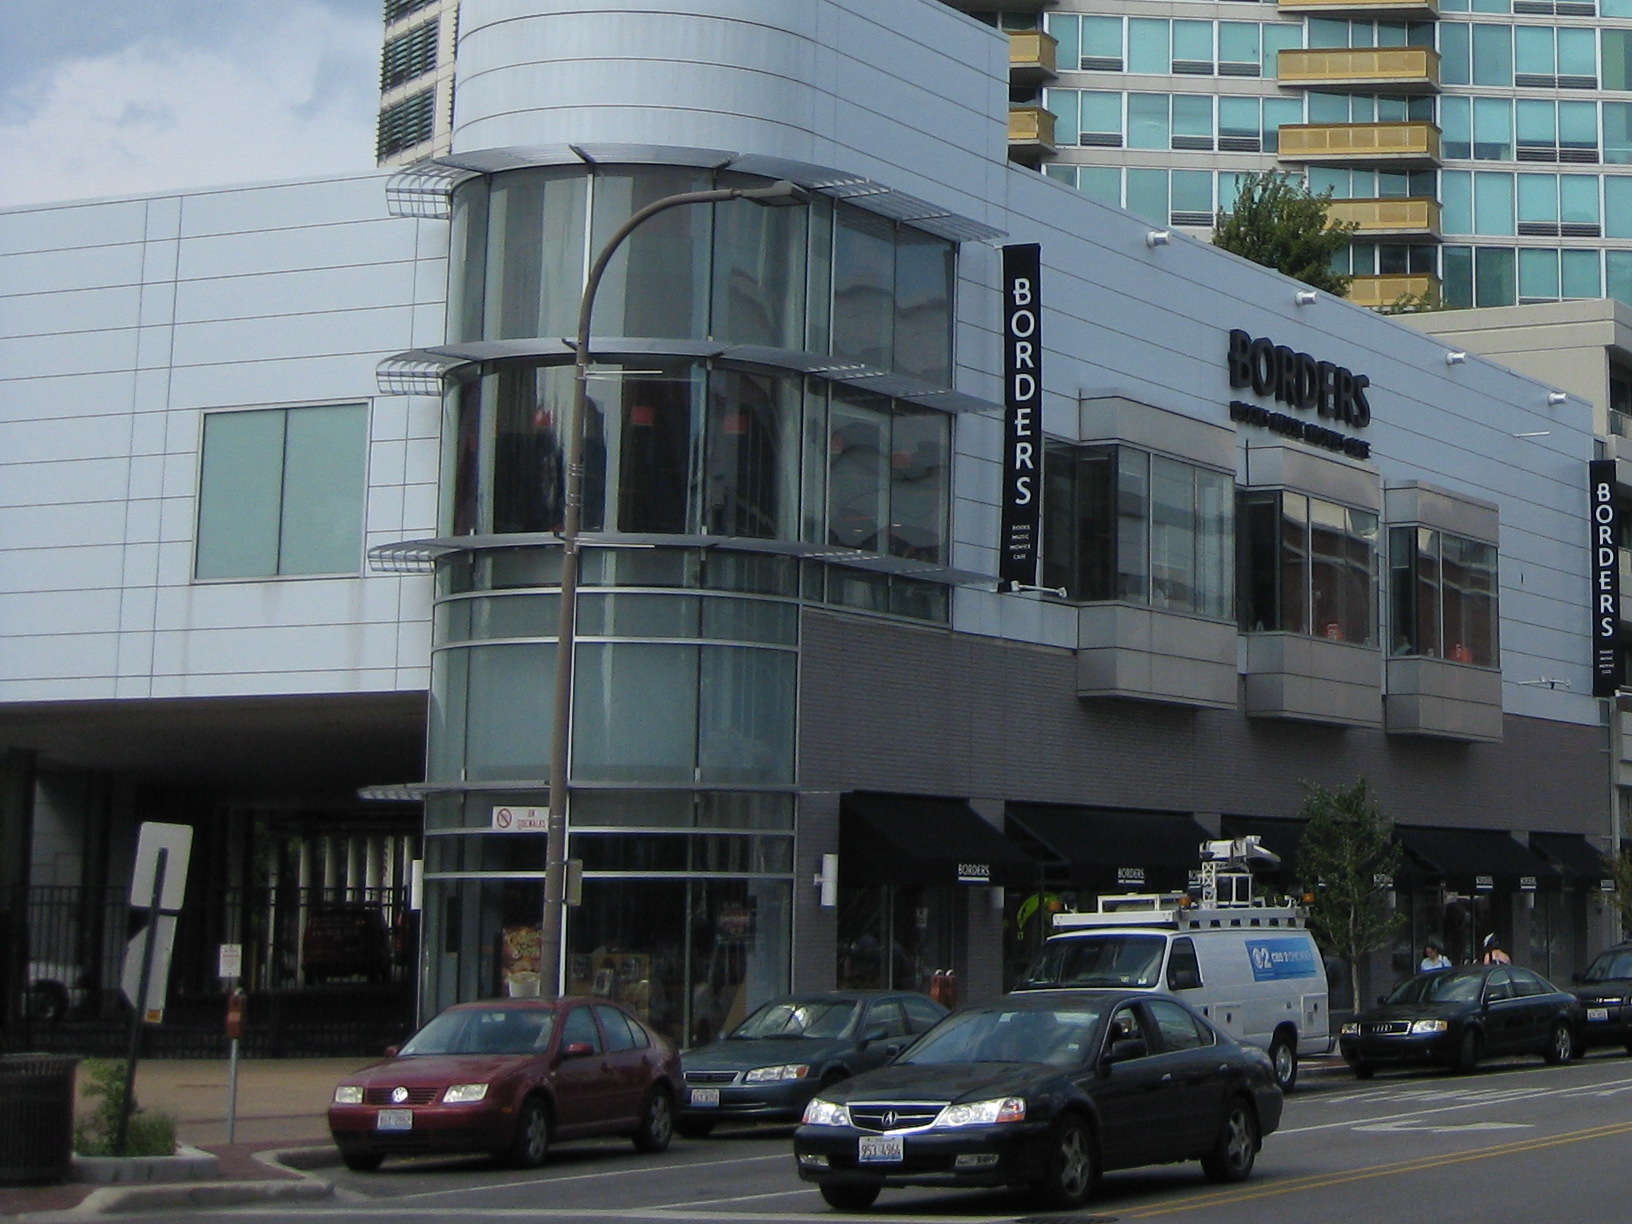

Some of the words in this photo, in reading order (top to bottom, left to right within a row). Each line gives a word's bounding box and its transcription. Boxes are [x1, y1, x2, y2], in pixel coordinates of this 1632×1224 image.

[1011, 277, 1036, 505] BORDERS
[1227, 329, 1371, 428] BORDERS
[1595, 482, 1615, 637] BORDERS
[958, 863, 991, 876] BORDERS
